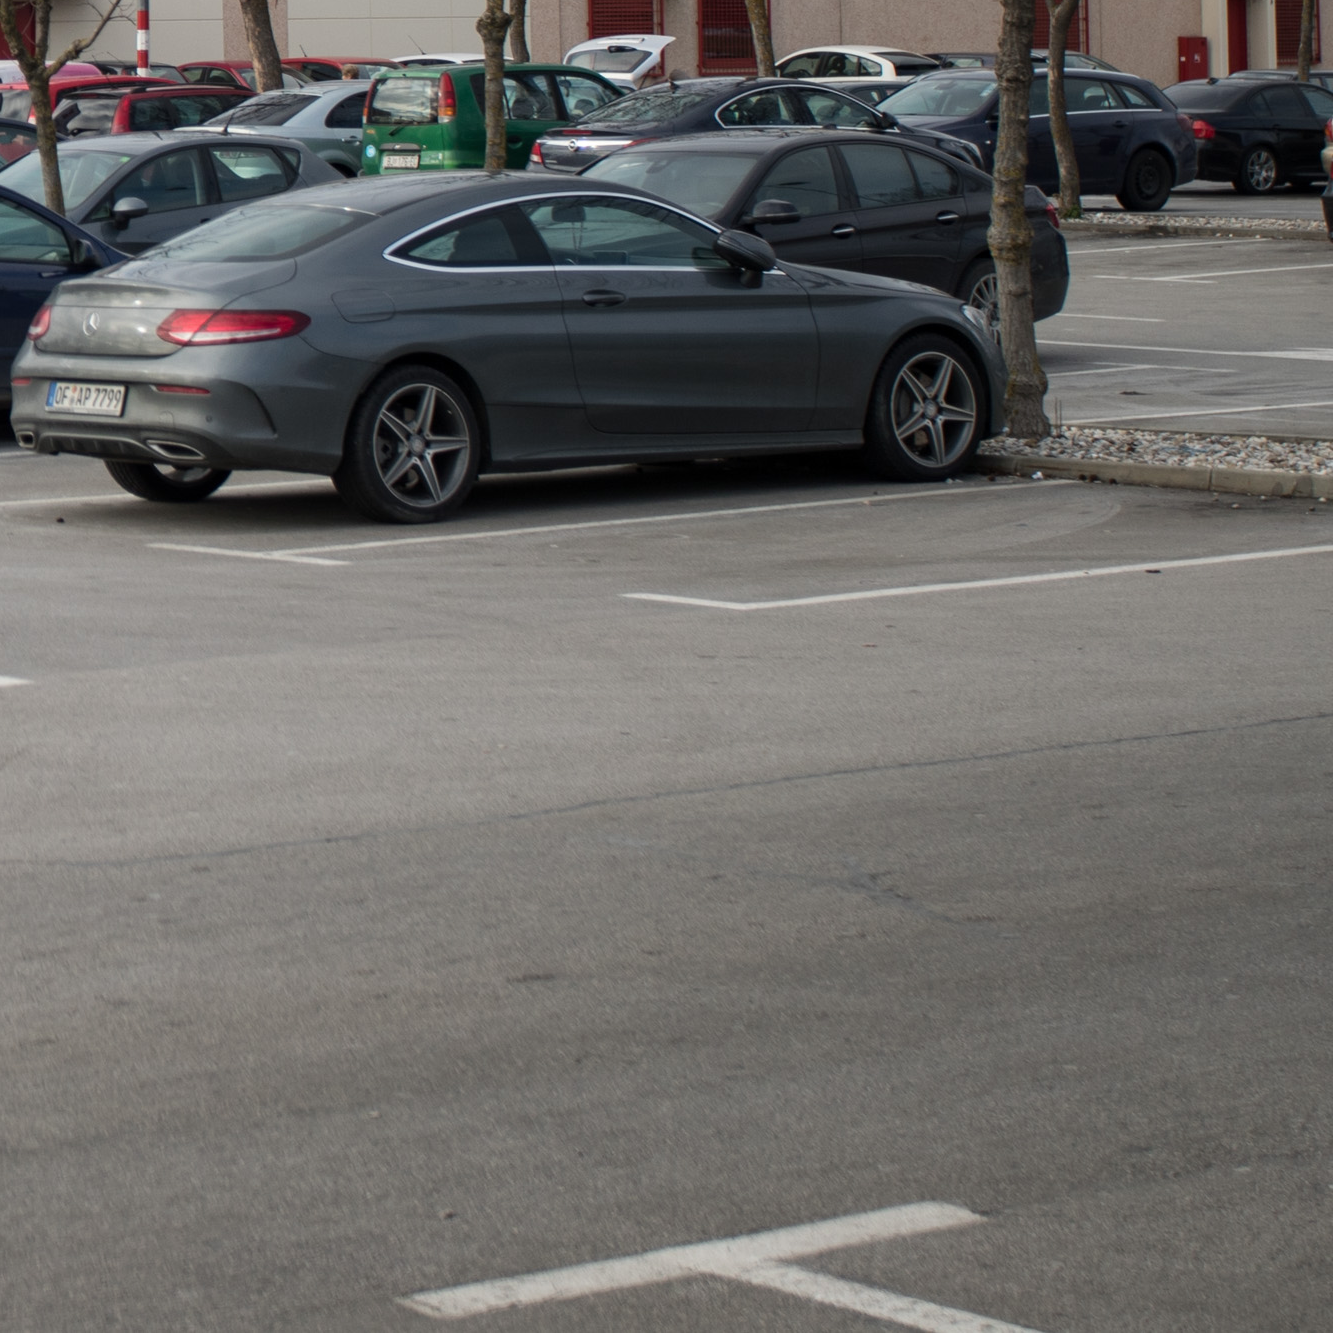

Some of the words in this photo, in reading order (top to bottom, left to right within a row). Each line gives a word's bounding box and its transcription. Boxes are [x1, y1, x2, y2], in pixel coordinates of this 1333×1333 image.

[55, 385, 70, 404] OF
[76, 387, 91, 406] AP
[93, 388, 122, 409] 7799
